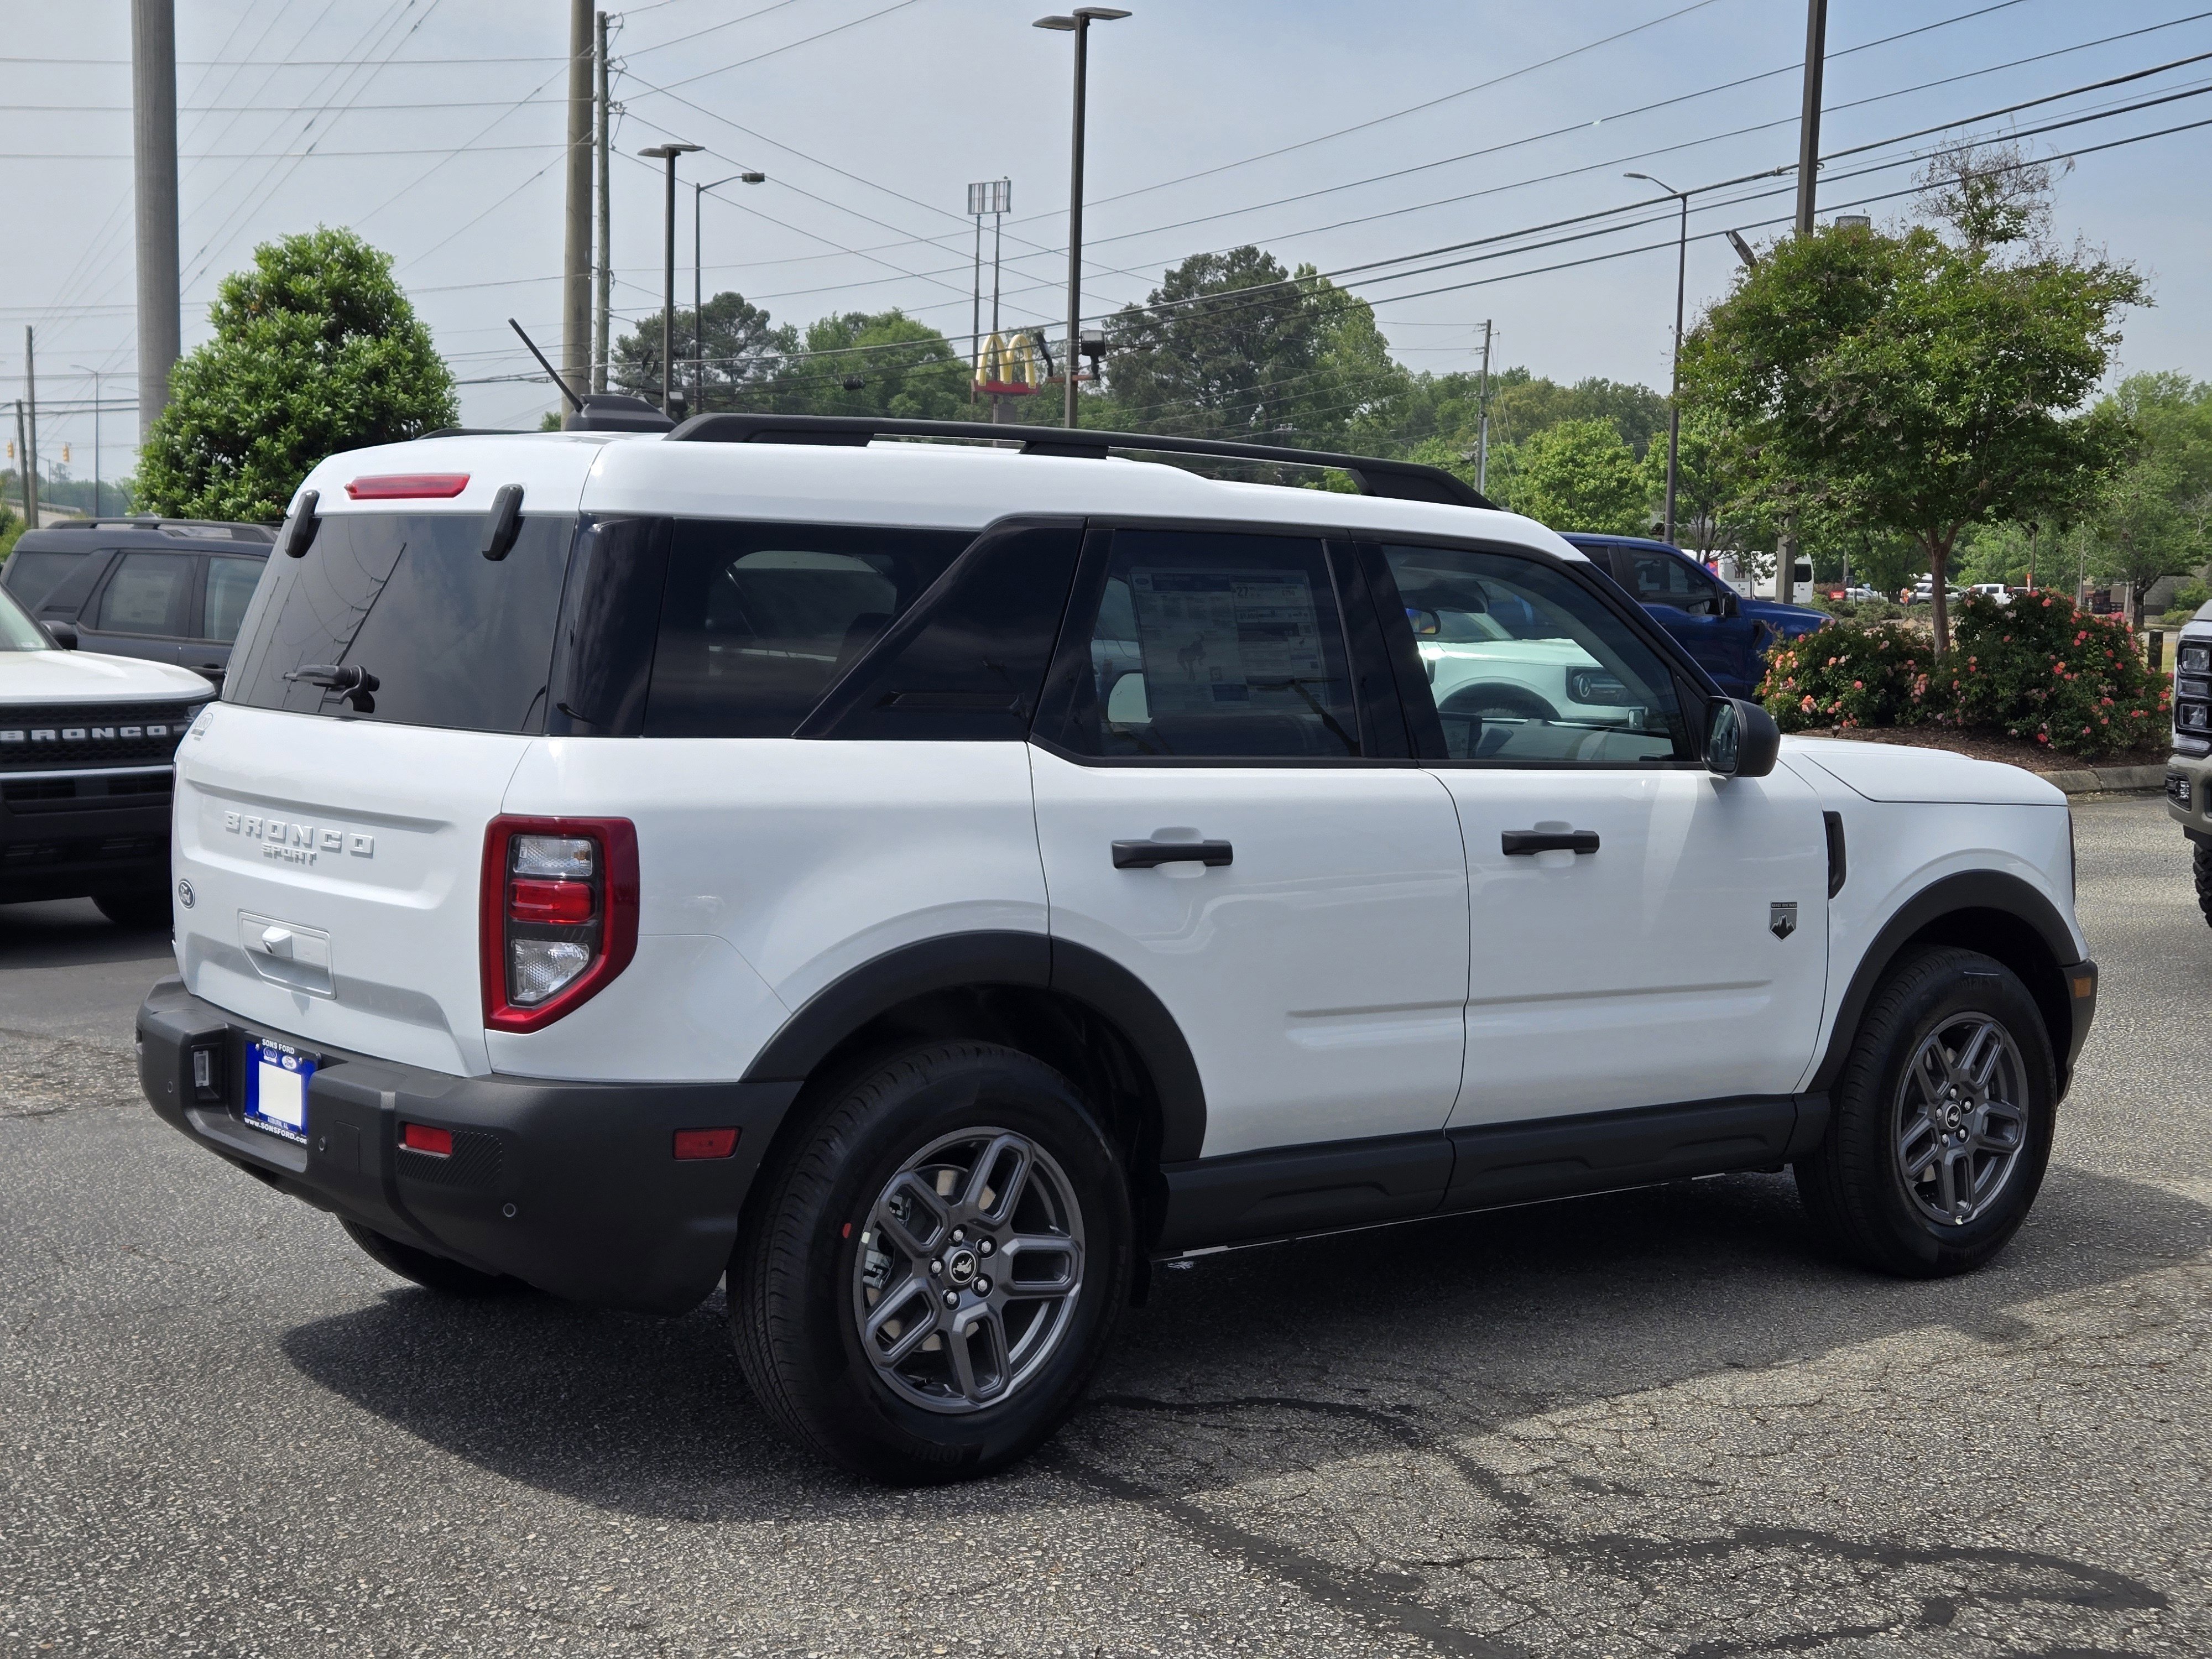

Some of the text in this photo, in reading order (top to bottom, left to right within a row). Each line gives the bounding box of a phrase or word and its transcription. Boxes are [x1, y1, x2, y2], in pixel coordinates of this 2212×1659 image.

[1237, 586, 1248, 597] 27
[0, 725, 167, 741] BRONCO
[224, 811, 374, 855] BRONCO
[260, 842, 317, 865] SPORT
[262, 1038, 295, 1055] SONS FORD
